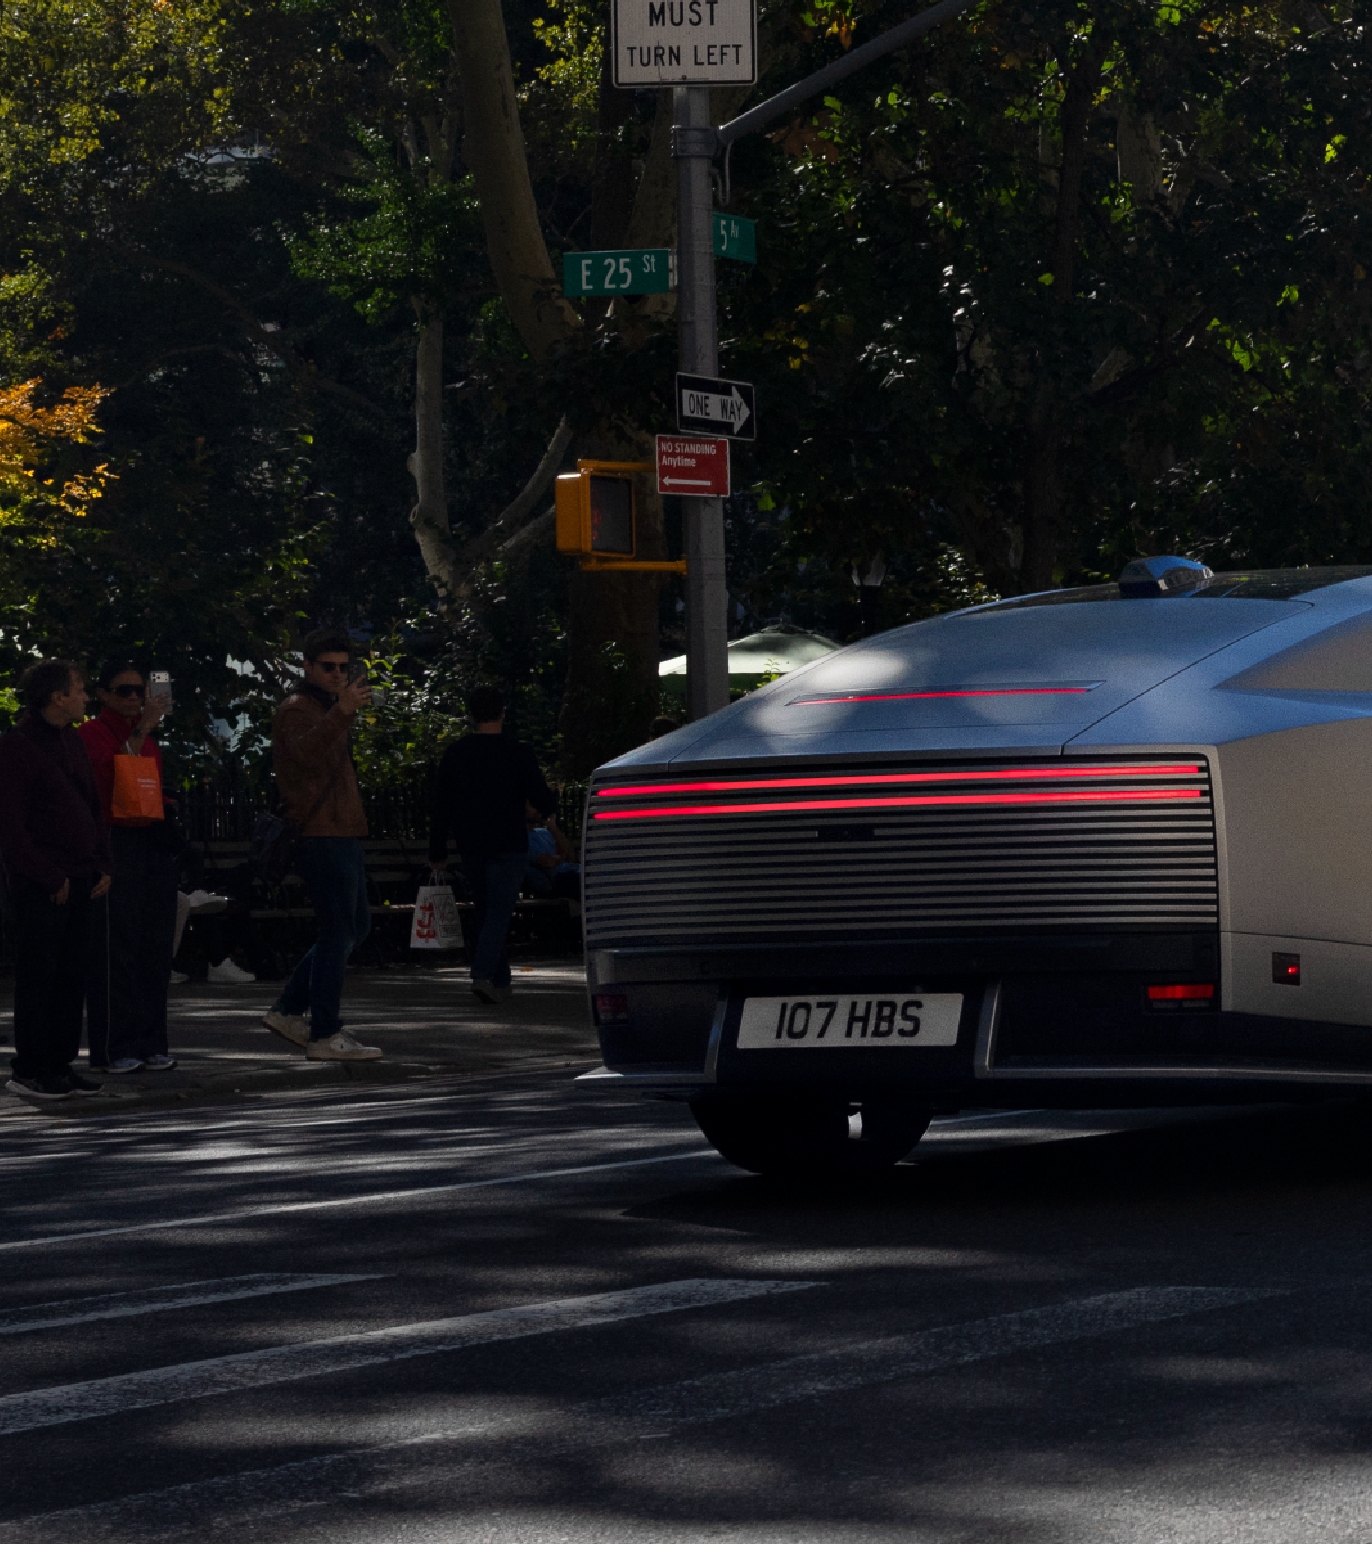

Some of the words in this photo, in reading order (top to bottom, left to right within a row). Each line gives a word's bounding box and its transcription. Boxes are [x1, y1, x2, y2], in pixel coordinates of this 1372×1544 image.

[649, 1, 719, 26] MUST
[627, 45, 681, 67] TURN
[694, 44, 743, 66] LEFT
[720, 219, 728, 251] 5
[581, 259, 593, 290] E
[603, 258, 633, 289] 25
[642, 254, 656, 273] St
[688, 393, 710, 417] ONE
[720, 398, 743, 422] WAY
[661, 442, 673, 453] NO
[675, 442, 717, 455] STANDING
[661, 455, 697, 468] Anytime
[775, 1002, 838, 1039] 107
[845, 1000, 923, 1038] HBS
